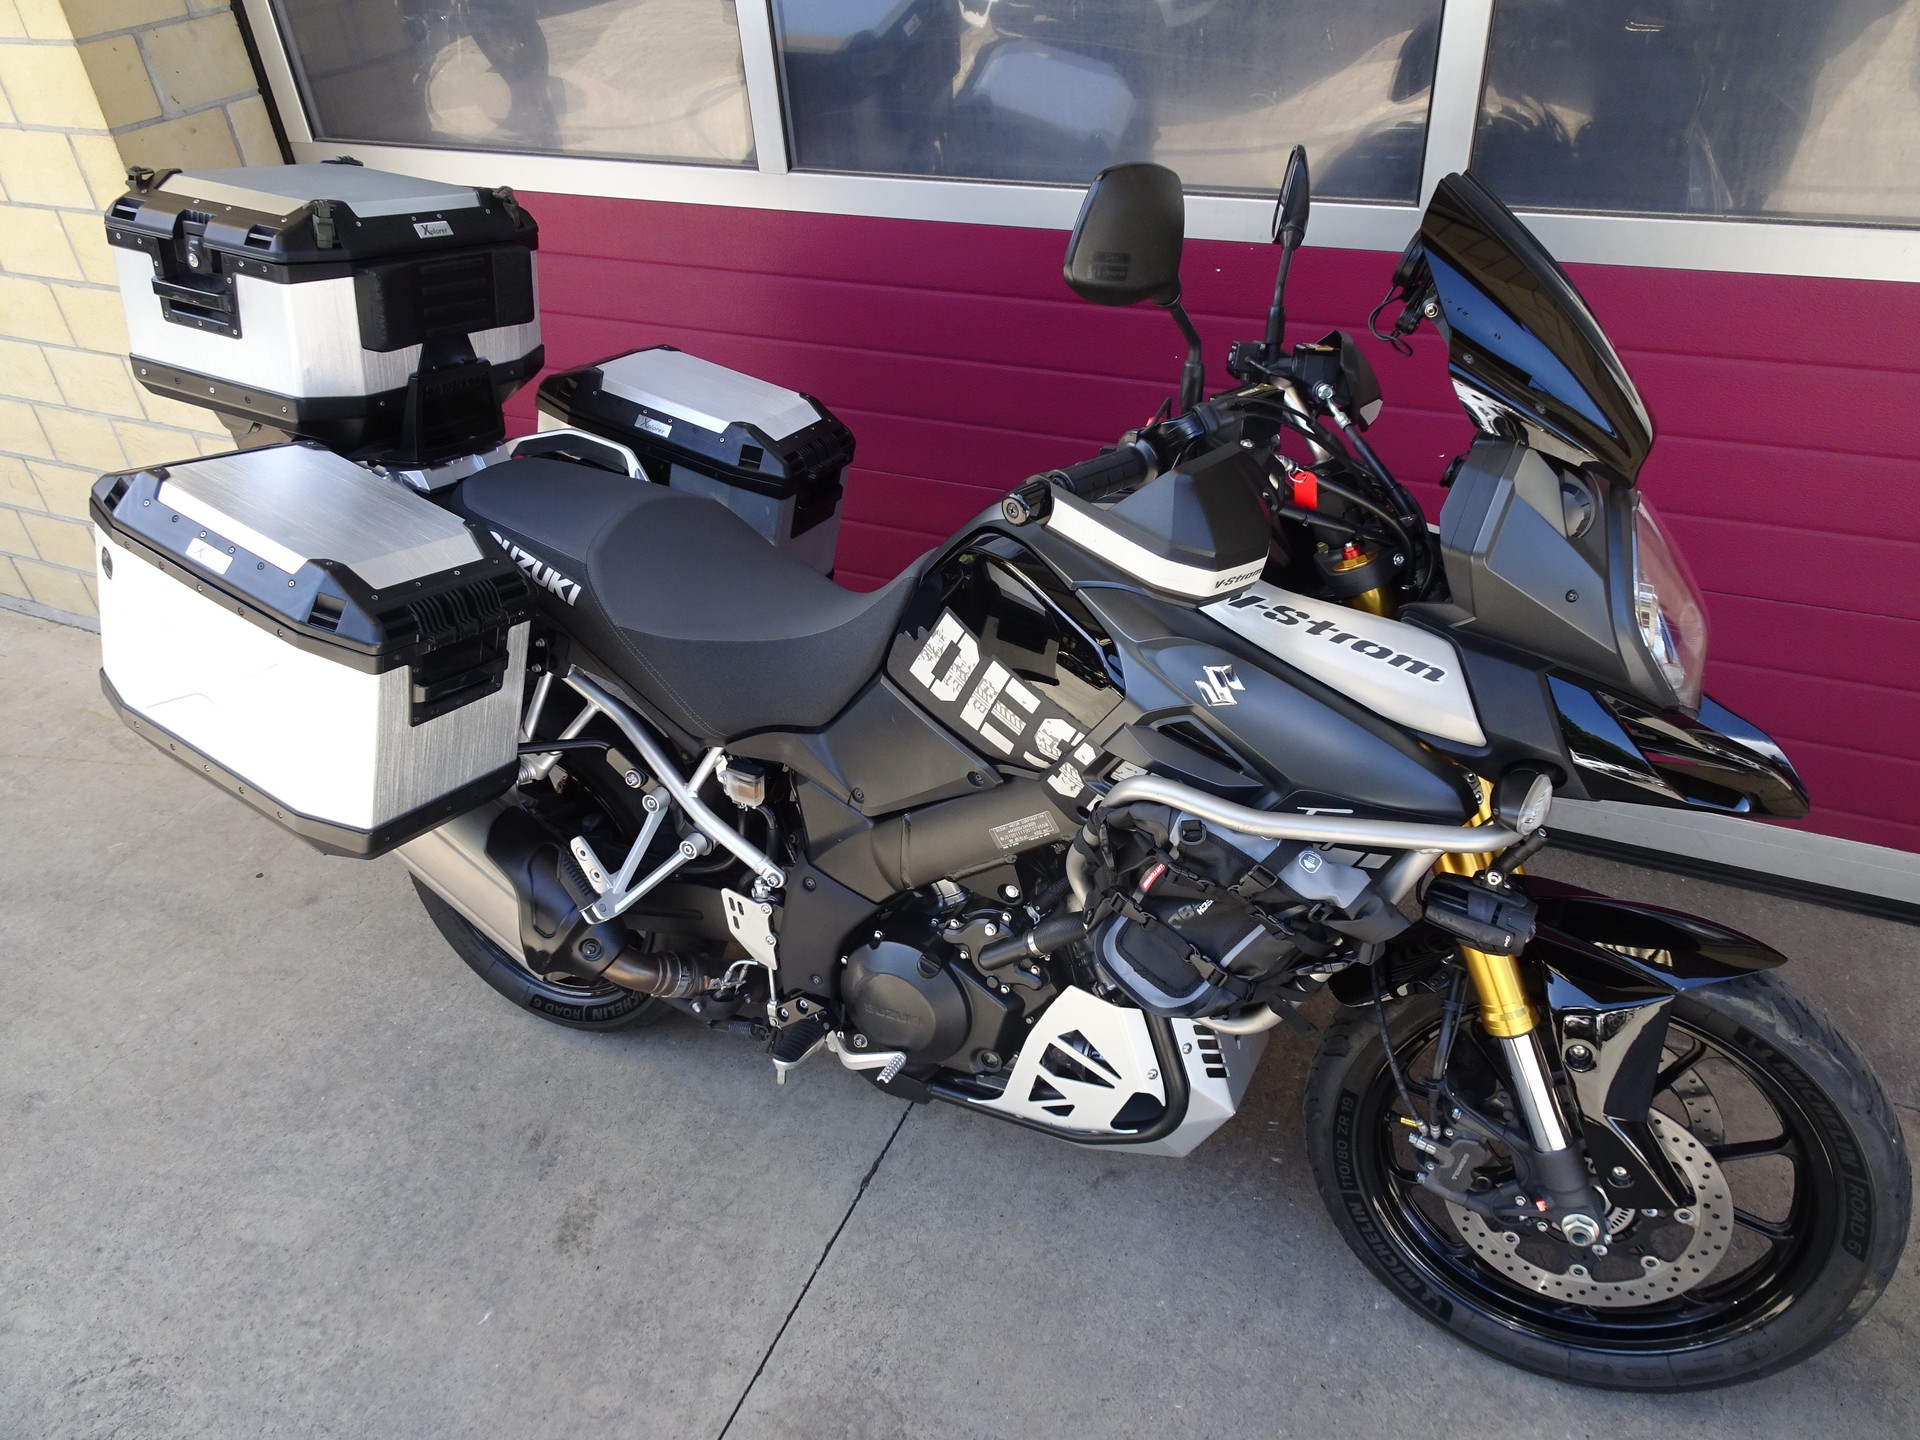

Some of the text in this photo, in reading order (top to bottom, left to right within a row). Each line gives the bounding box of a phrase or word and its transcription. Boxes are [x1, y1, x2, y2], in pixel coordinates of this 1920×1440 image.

[421, 225, 448, 237] Xplorer
[640, 417, 665, 434] Xplorer
[532, 997, 542, 1008] 6
[544, 1002, 581, 1019] ROAD
[1337, 1115, 1350, 1135] ZR
[1774, 1060, 1868, 1256] MICHELIN ROAD 6
[1348, 1201, 1423, 1292] MICHELIN
